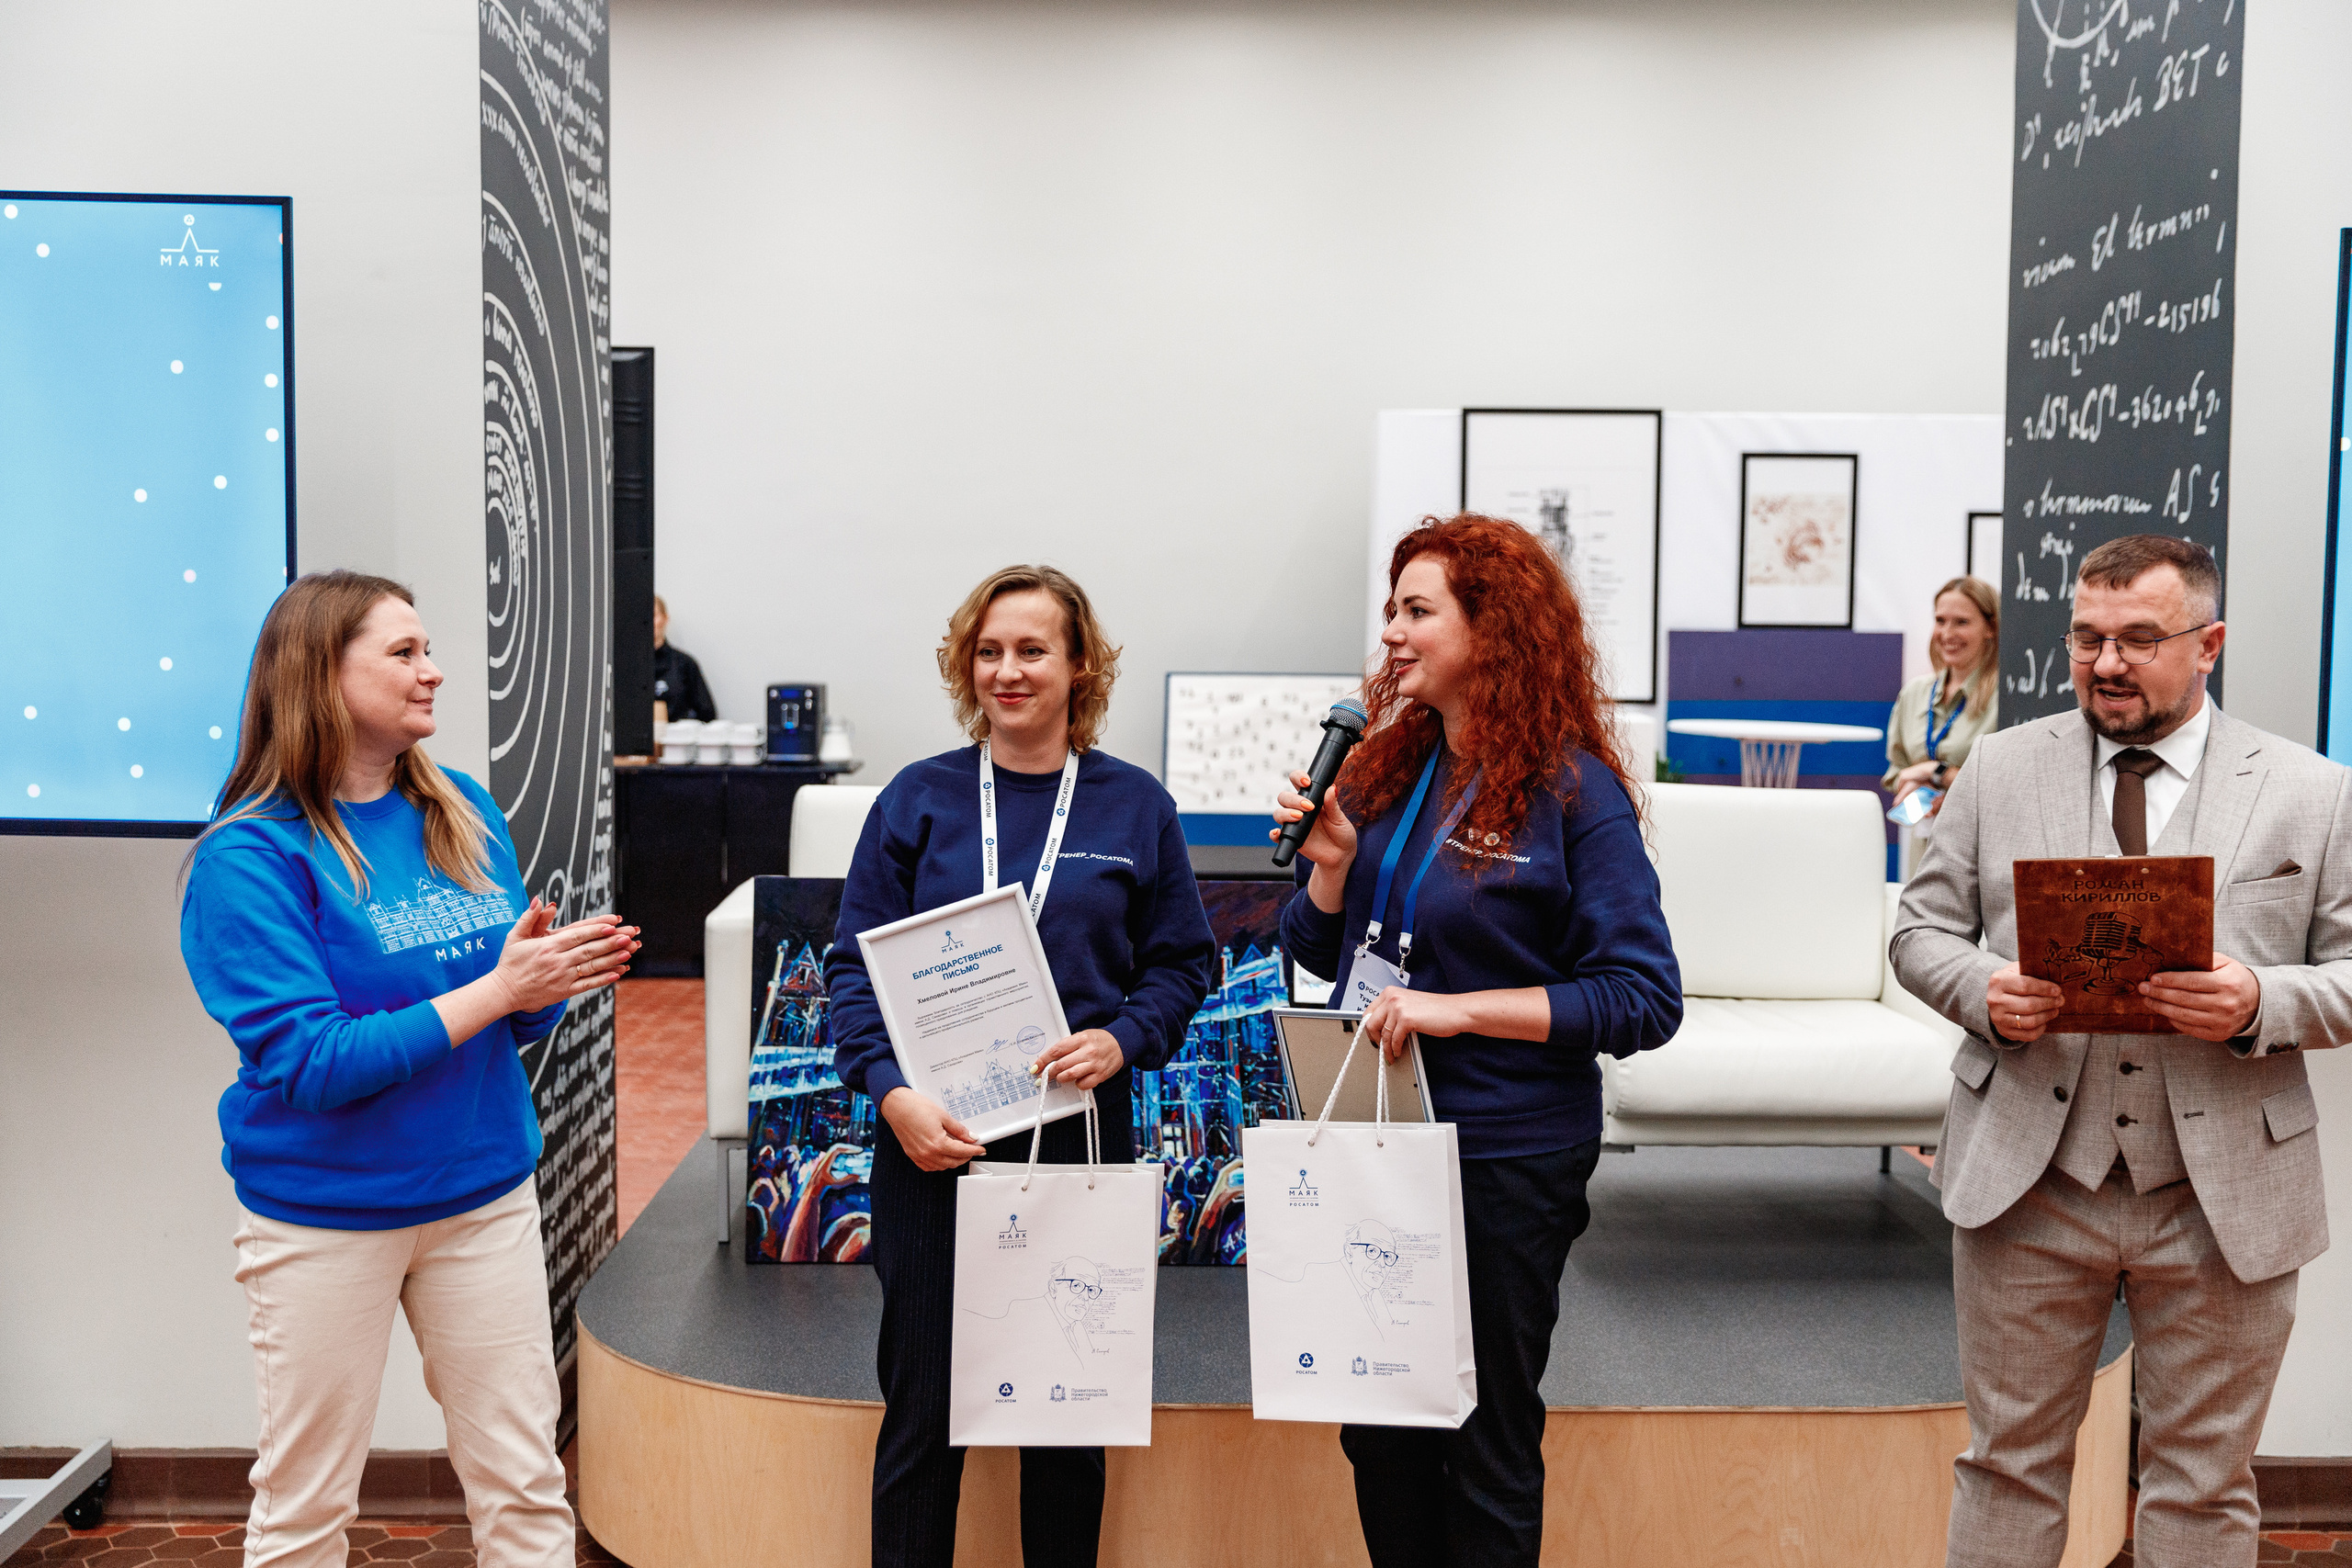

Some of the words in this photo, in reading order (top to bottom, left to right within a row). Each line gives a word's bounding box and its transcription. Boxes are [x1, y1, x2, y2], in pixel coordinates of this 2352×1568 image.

[160, 254, 220, 267] МАЯК
[1060, 777, 1071, 807] РОСАТОМ
[1045, 838, 1057, 864] РОСАТОМ
[2074, 879, 2145, 890] РОМАН
[2061, 891, 2162, 903] КИРИЛЛОВ
[435, 936, 486, 962] МАЯК
[942, 942, 965, 953] МАЯК
[912, 943, 1003, 980] БЛАГОДАРСТВЕННОЕ
[942, 963, 980, 981] ПИСЬМО
[917, 990, 949, 1005] Хмеловой
[949, 984, 969, 994] Ирине
[969, 967, 1016, 987] Владимировне
[1365, 986, 1380, 997] РОСА
